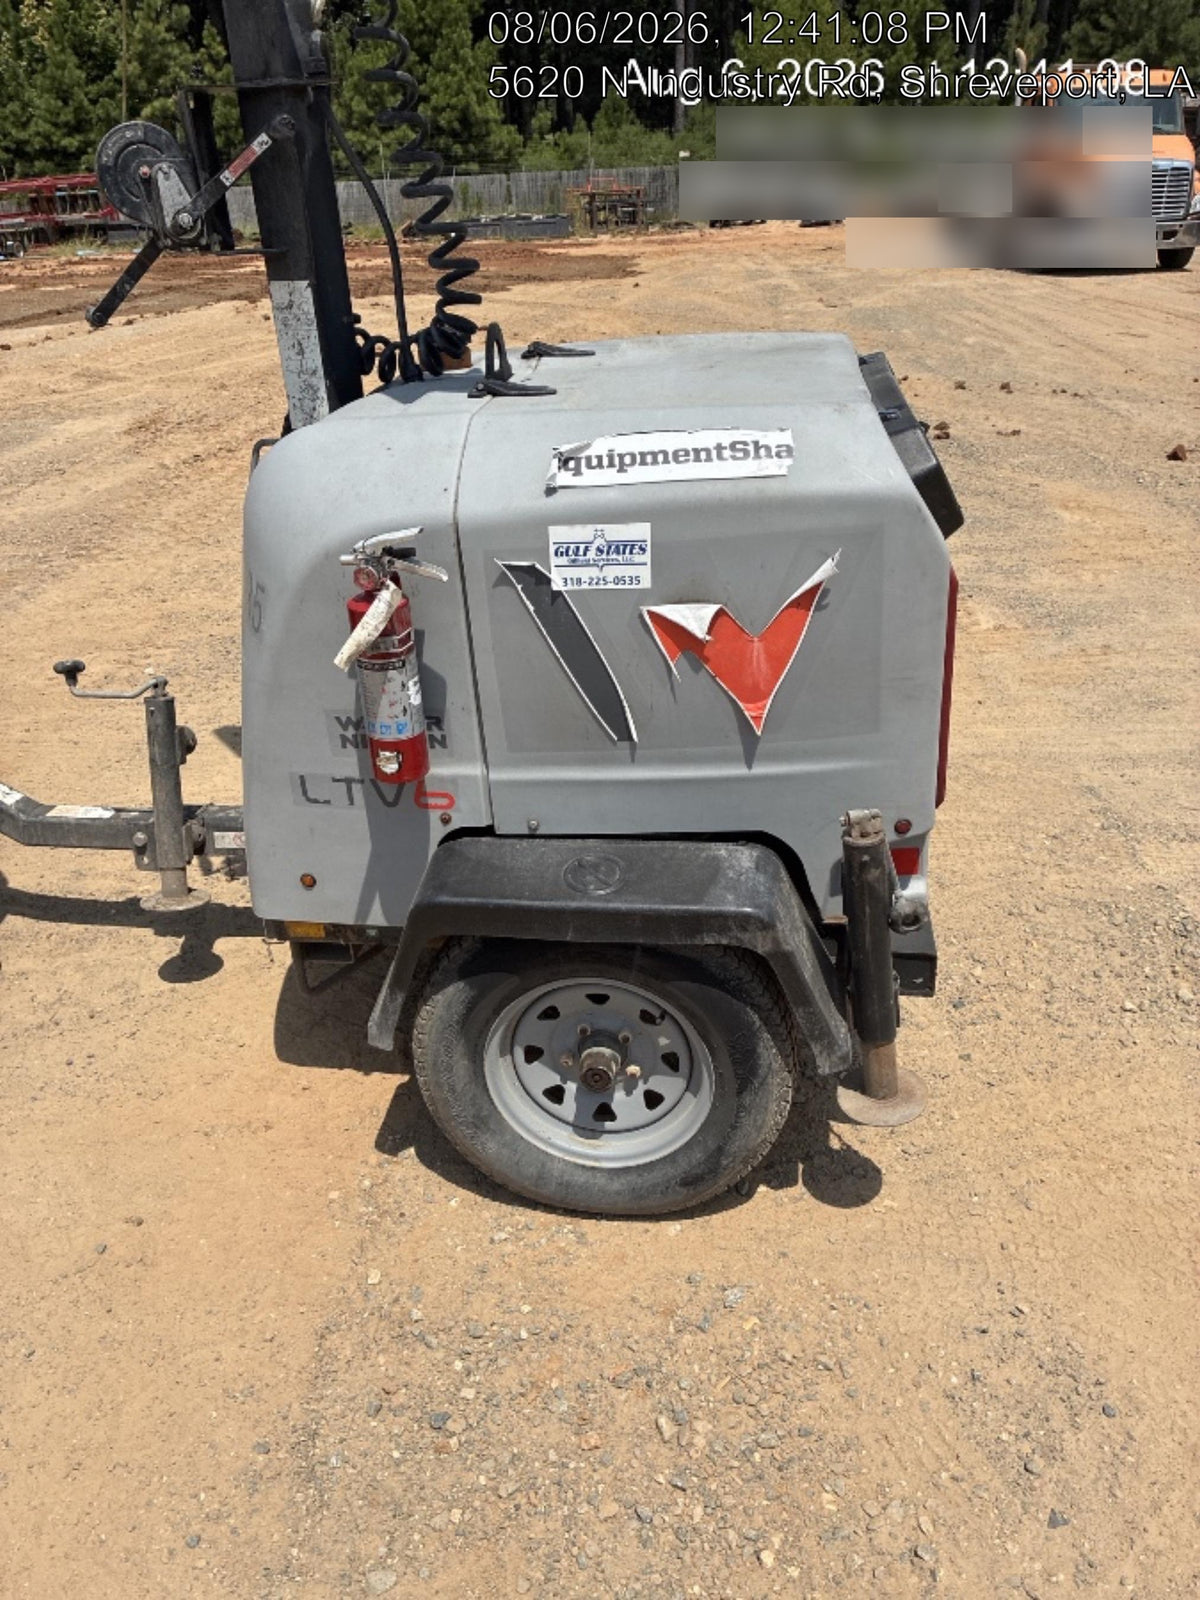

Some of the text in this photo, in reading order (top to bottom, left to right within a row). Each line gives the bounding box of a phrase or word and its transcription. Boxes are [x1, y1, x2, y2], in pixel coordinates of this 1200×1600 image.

[559, 439, 793, 476] quipmentSha
[554, 543, 648, 558] GULF STATES
[562, 575, 641, 588] 318-225-0535
